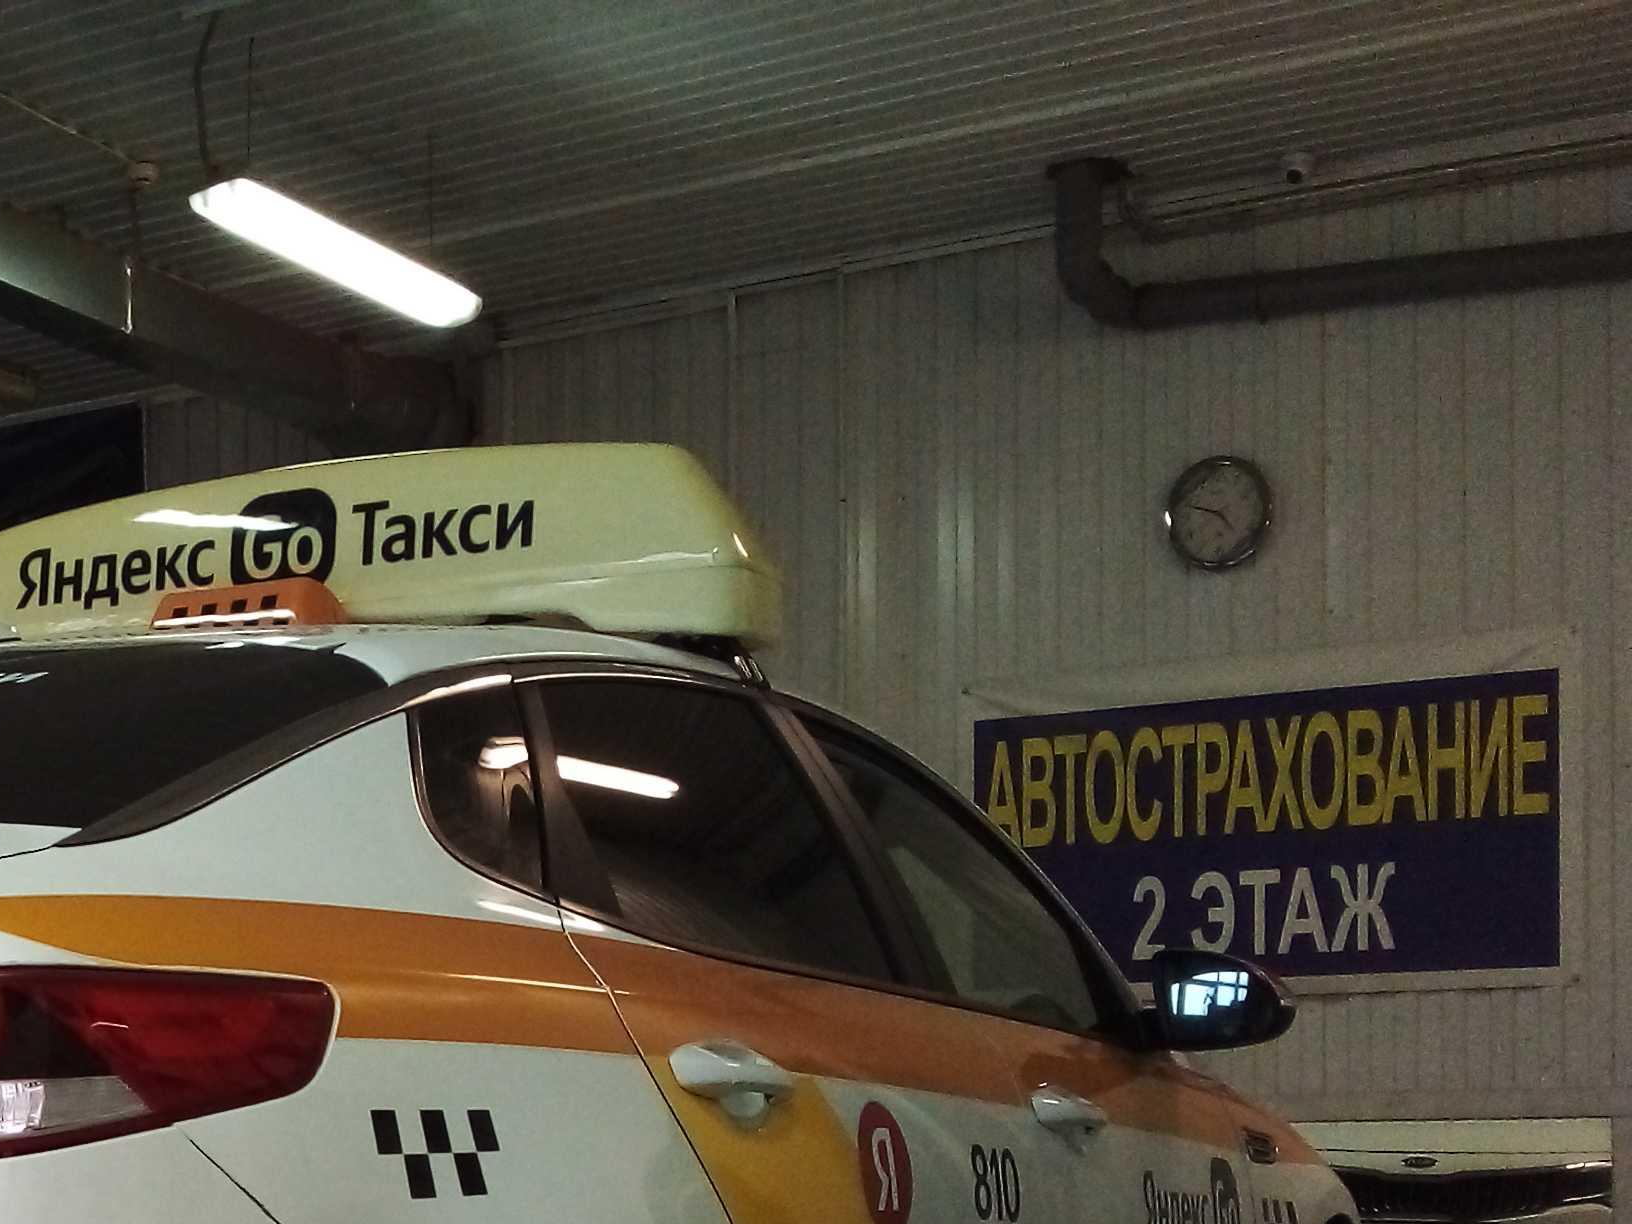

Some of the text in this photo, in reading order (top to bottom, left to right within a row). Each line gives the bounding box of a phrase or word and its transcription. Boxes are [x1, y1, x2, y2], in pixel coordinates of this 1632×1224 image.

[15, 499, 536, 610] Яндекс Go Такси
[985, 694, 1551, 848] АВТОСТРАХОВАНИЕ
[1131, 861, 1396, 961] 2 ЭТАЖ
[870, 1126, 901, 1213] Я
[970, 1143, 1021, 1223] 810
